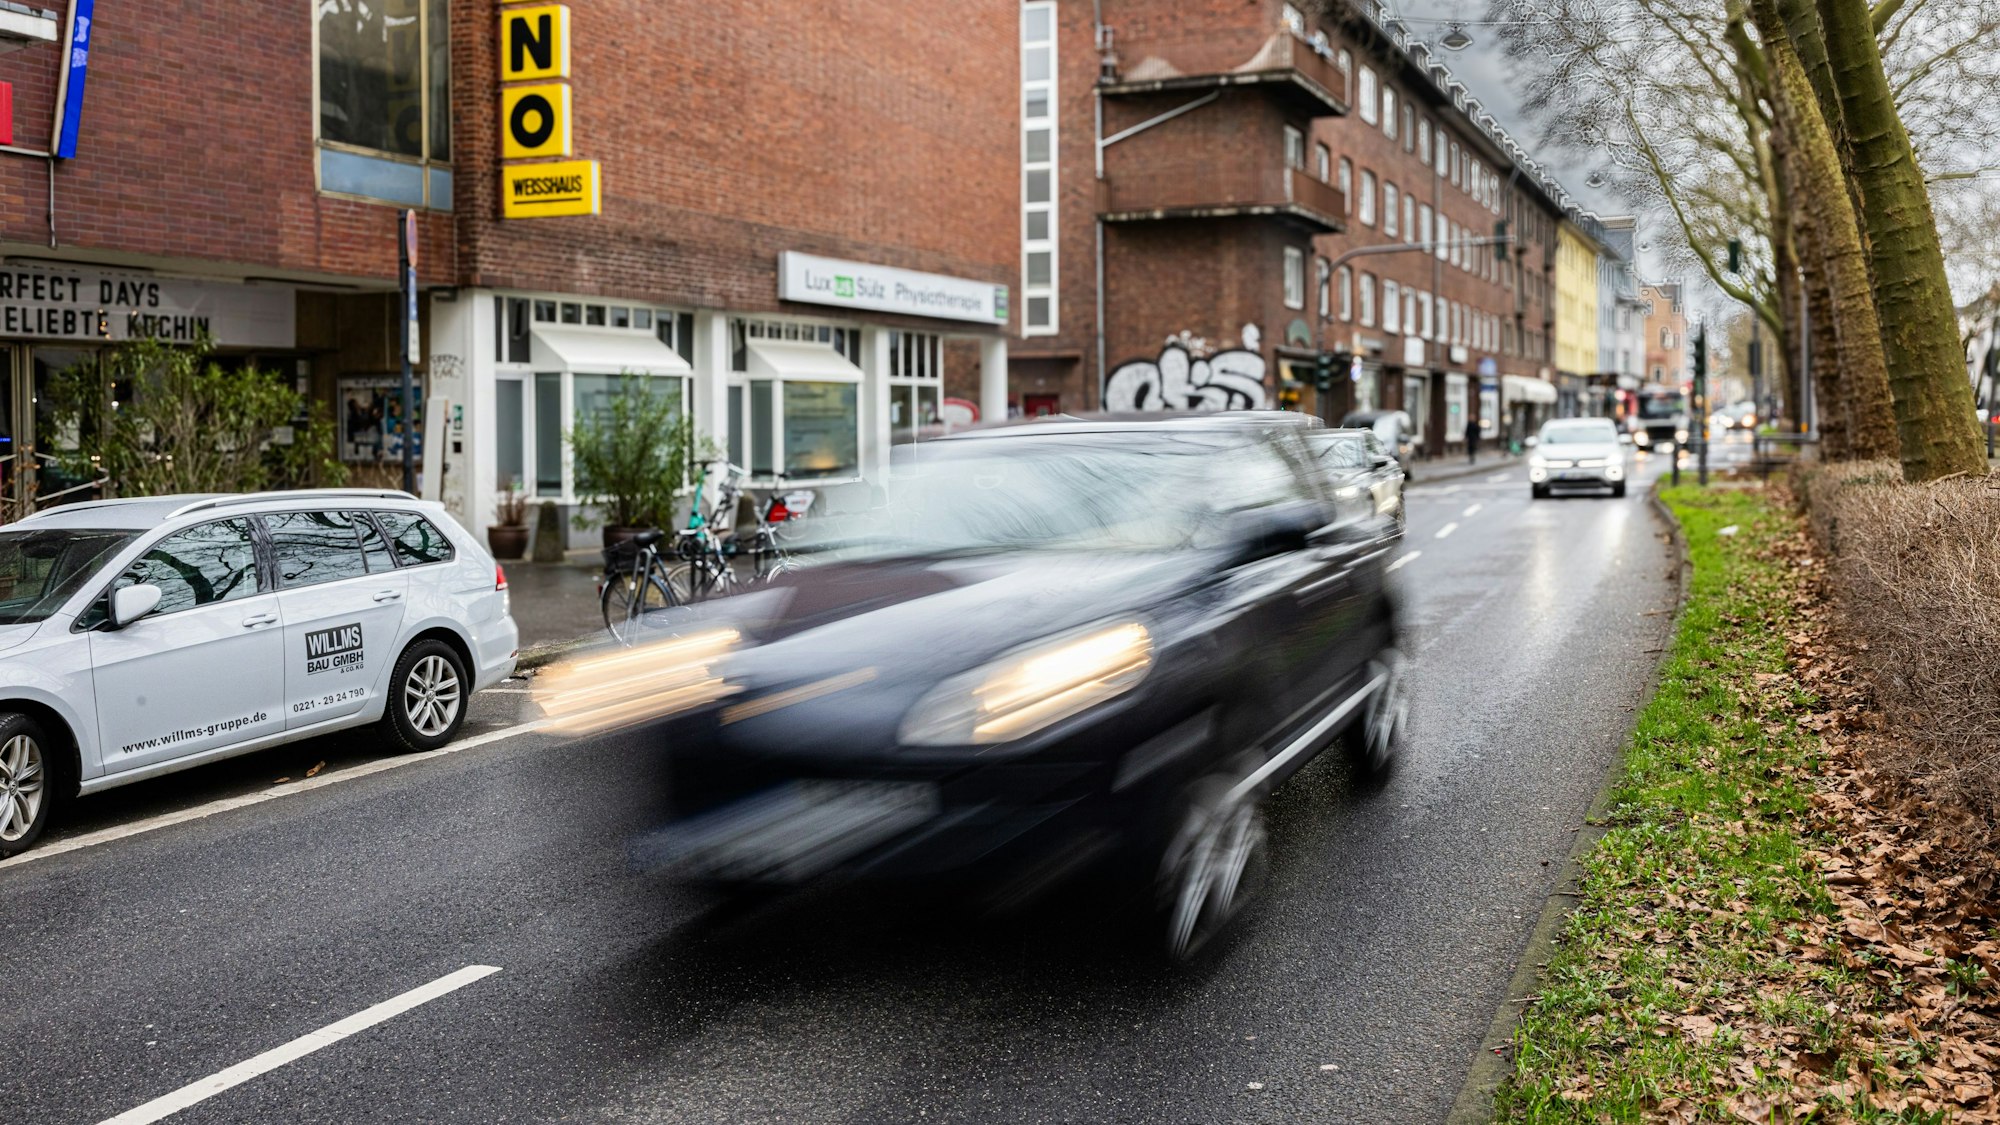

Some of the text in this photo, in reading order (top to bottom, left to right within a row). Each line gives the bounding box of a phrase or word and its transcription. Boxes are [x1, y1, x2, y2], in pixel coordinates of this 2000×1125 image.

[513, 175, 583, 197] WEISSHAUS
[100, 280, 160, 308] DAYS
[894, 282, 983, 313] Physiotherapie
[307, 625, 362, 656] WILLMS
[307, 650, 364, 673] BAU GMBH
[355, 663, 364, 671] KG
[293, 699, 315, 713] 0221
[323, 695, 334, 706] 29
[336, 691, 347, 702] 24
[348, 687, 365, 698] 790
[122, 711, 267, 754] www.willms-gruppe.de
